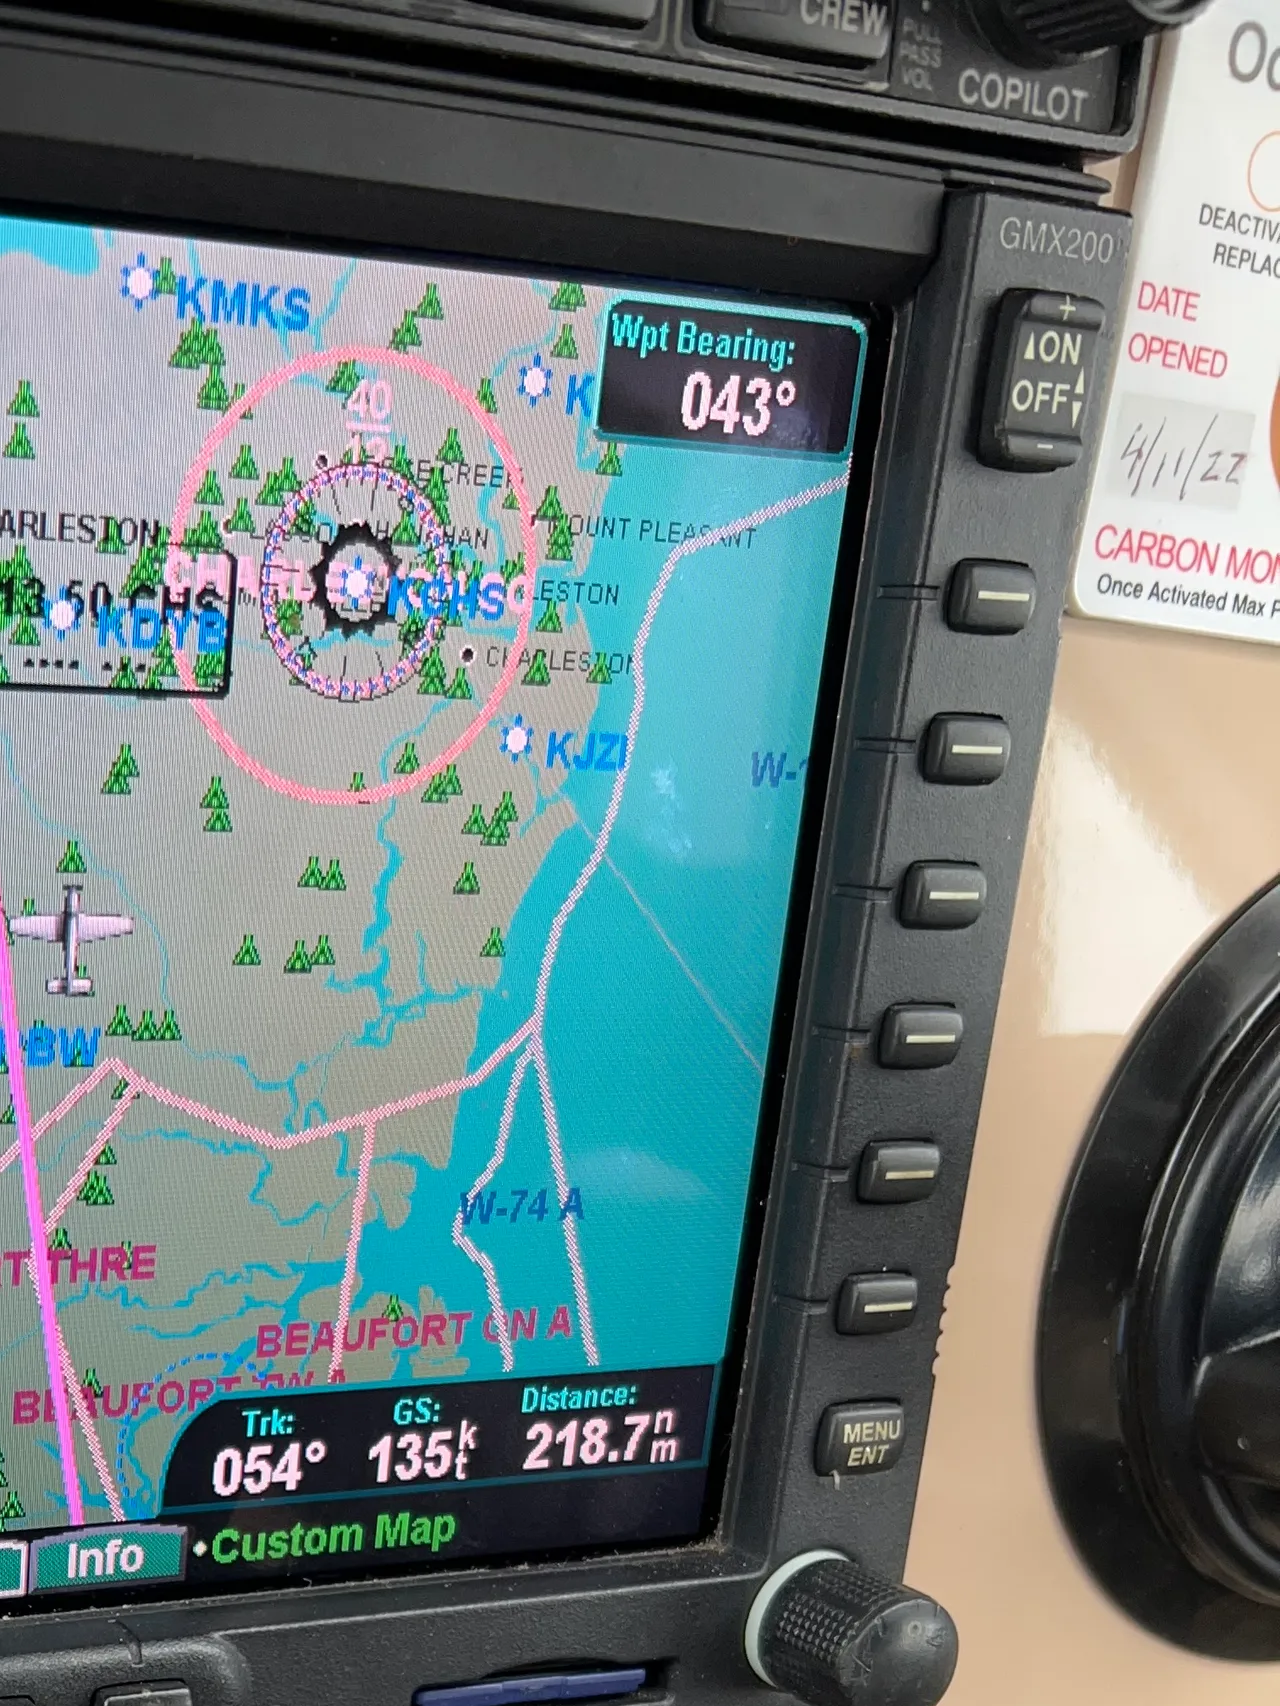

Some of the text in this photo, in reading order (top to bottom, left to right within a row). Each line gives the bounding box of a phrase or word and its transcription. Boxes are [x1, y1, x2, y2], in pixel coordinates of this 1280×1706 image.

[958, 68, 1089, 122] COPILOT
[999, 216, 1114, 265] GMX200
[175, 275, 312, 331] KMKS
[1137, 280, 1200, 322] DATE
[612, 312, 796, 371] Wpt Bearing:
[1039, 331, 1083, 366] ON
[1128, 332, 1228, 379] OPENED
[347, 380, 392, 420] 40
[1011, 377, 1070, 415] OFF
[1095, 524, 1220, 576] CARBON
[1097, 573, 1144, 599] Once
[1148, 581, 1228, 612] Activated
[1232, 593, 1266, 617] Max
[751, 752, 809, 788] W-
[460, 1189, 550, 1225] W-74
[257, 1312, 472, 1358] BEAUFORT
[545, 1306, 572, 1340] A
[394, 1398, 441, 1425] GS:
[522, 1384, 638, 1414] Distance:
[243, 1409, 294, 1438] Trk:
[843, 1420, 903, 1445] MENU
[846, 1444, 888, 1465] ENT
[212, 1511, 456, 1563] Custom Map
[67, 1539, 145, 1580] Info
